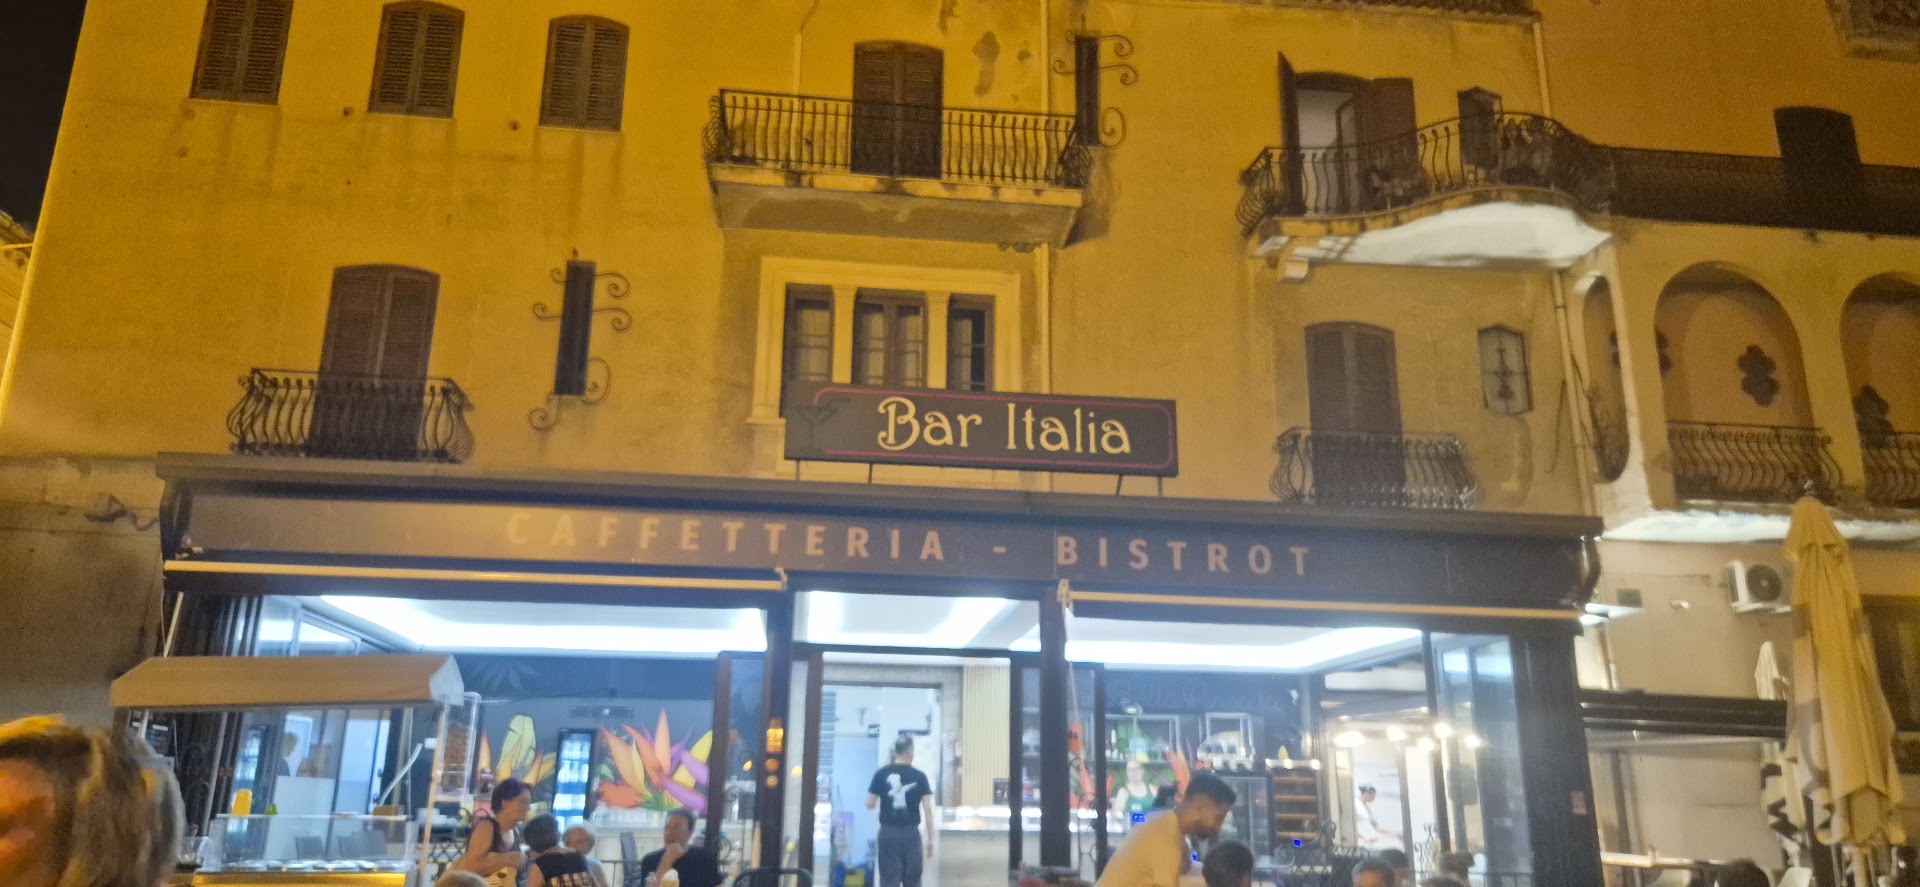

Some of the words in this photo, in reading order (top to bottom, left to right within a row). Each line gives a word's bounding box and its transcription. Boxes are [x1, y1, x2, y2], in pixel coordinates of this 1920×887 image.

[877, 396, 983, 452] Bar
[1006, 402, 1131, 454] Italia
[506, 511, 944, 561] CAFFETTERIA
[1056, 535, 1310, 576] BISTROT
